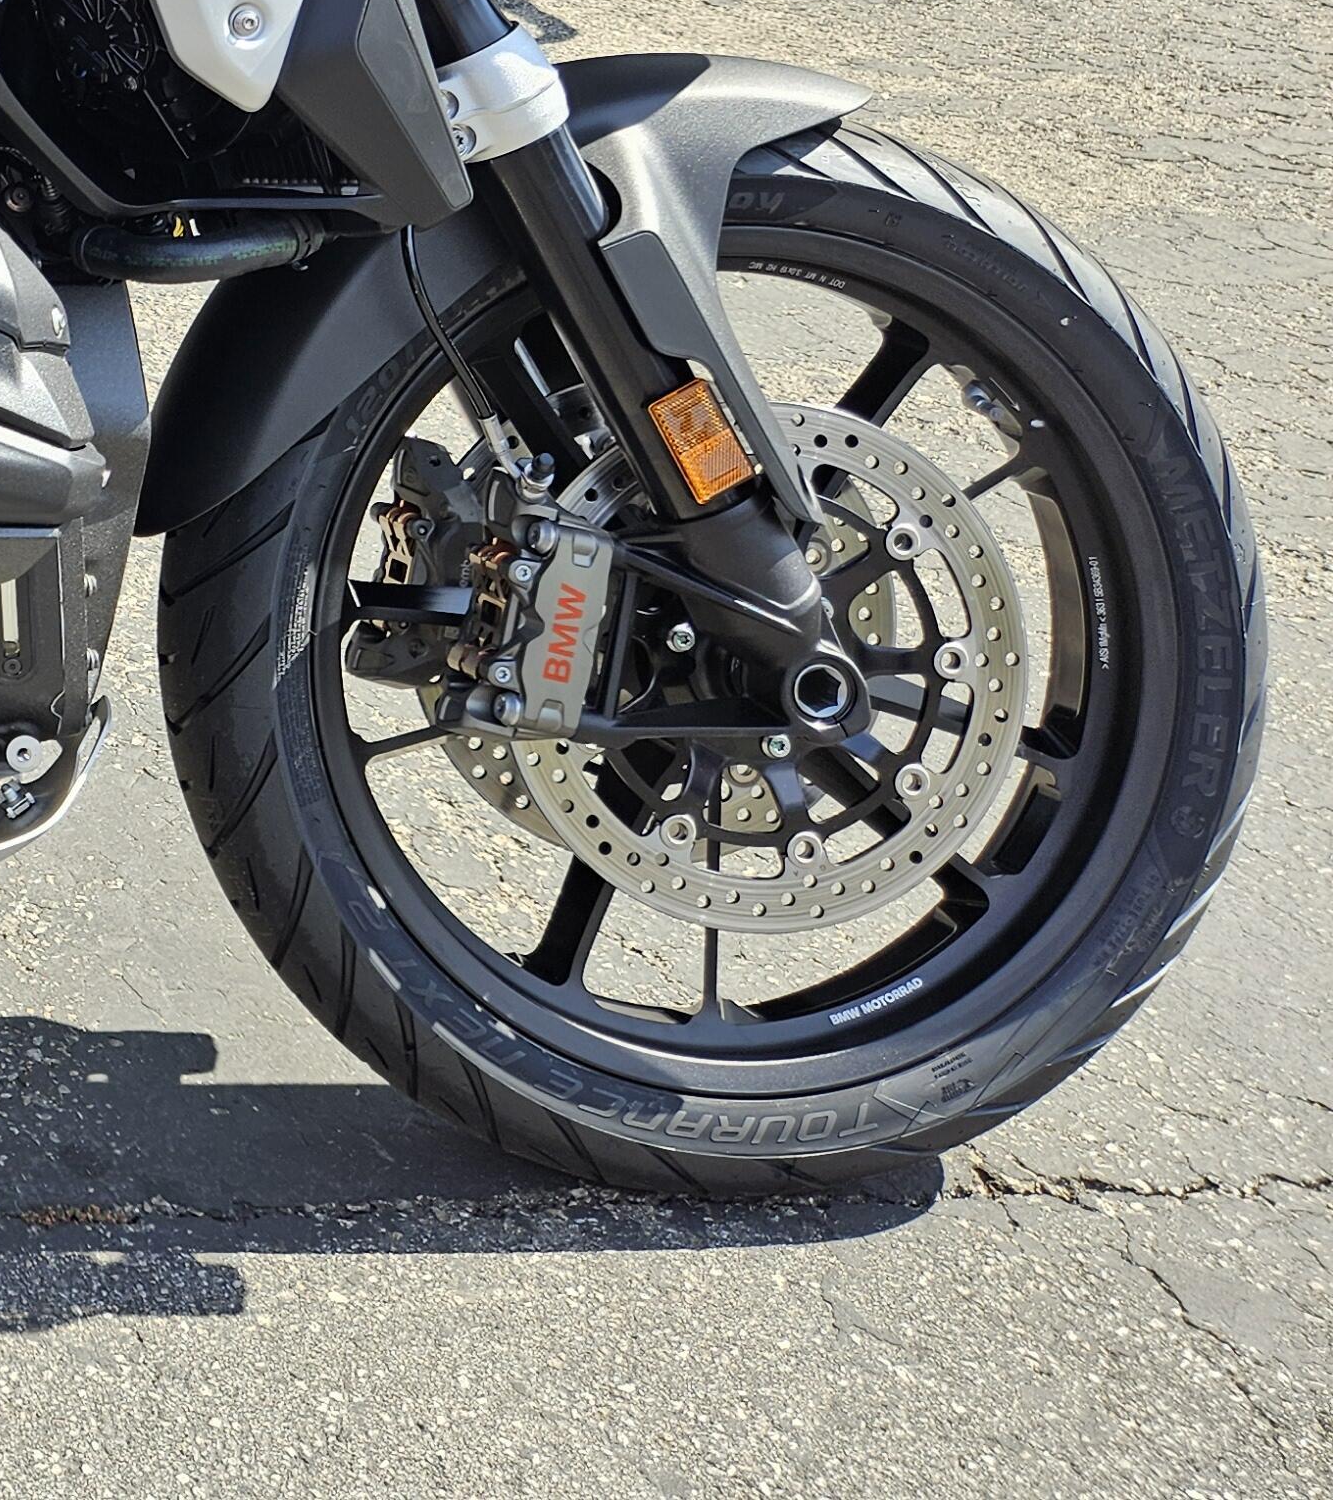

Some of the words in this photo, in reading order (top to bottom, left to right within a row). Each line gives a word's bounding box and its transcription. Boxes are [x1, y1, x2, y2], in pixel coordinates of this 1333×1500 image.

[542, 582, 587, 684] BMW
[1149, 446, 1237, 797] METZELER
[374, 934, 525, 1078] NEXT
[828, 1006, 860, 1026] BMW
[859, 977, 923, 1016] MOTORRAD
[531, 1062, 881, 1144] TOURANCE
